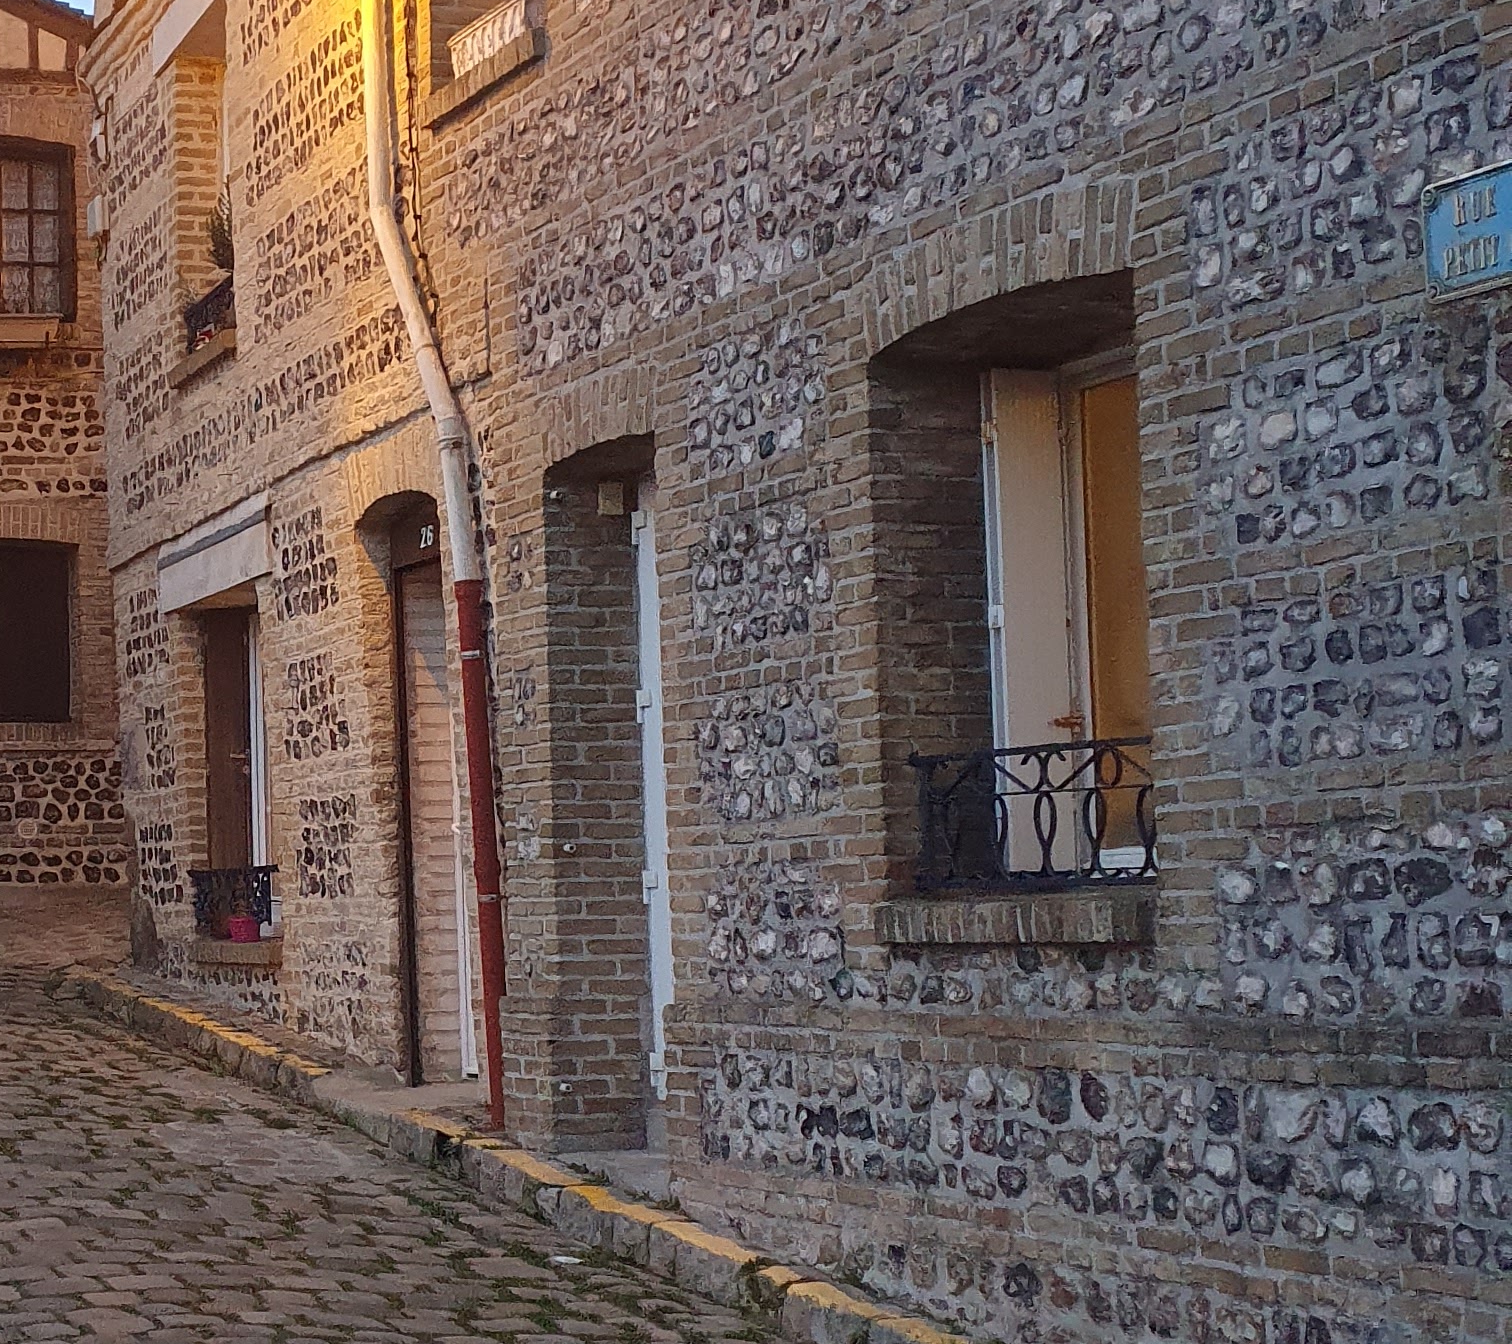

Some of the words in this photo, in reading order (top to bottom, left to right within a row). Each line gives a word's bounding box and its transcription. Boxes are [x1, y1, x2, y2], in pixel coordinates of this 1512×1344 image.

[1452, 186, 1497, 227] RUE
[1444, 233, 1500, 280] PETIT
[419, 524, 434, 549] 26
